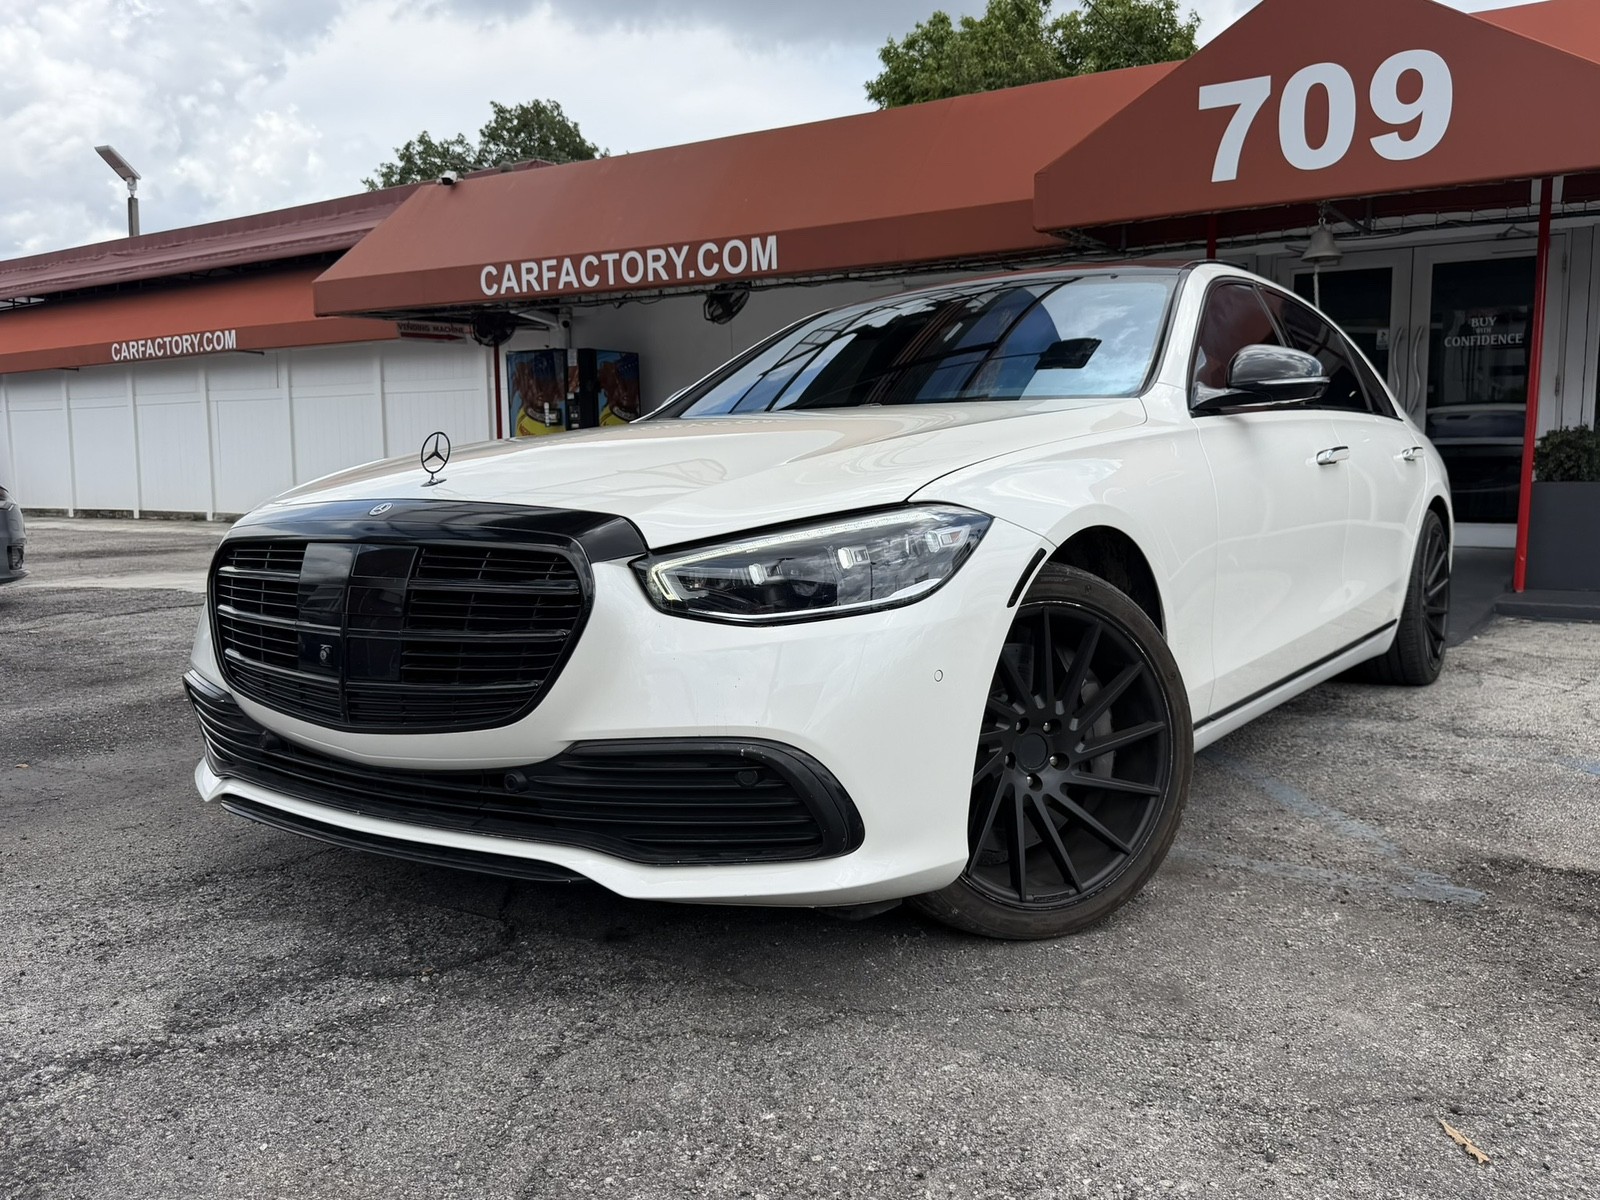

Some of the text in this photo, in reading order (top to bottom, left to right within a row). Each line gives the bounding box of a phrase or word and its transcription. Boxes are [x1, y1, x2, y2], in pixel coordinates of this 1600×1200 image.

[1199, 49, 1453, 183] 709
[480, 235, 778, 296] CARFACTORY.COM
[397, 321, 465, 334] VENDING MACHINE
[1471, 316, 1497, 328] BUY
[111, 329, 237, 362] CARFACTORY.COM
[1444, 333, 1523, 348] CONFIDENCE
